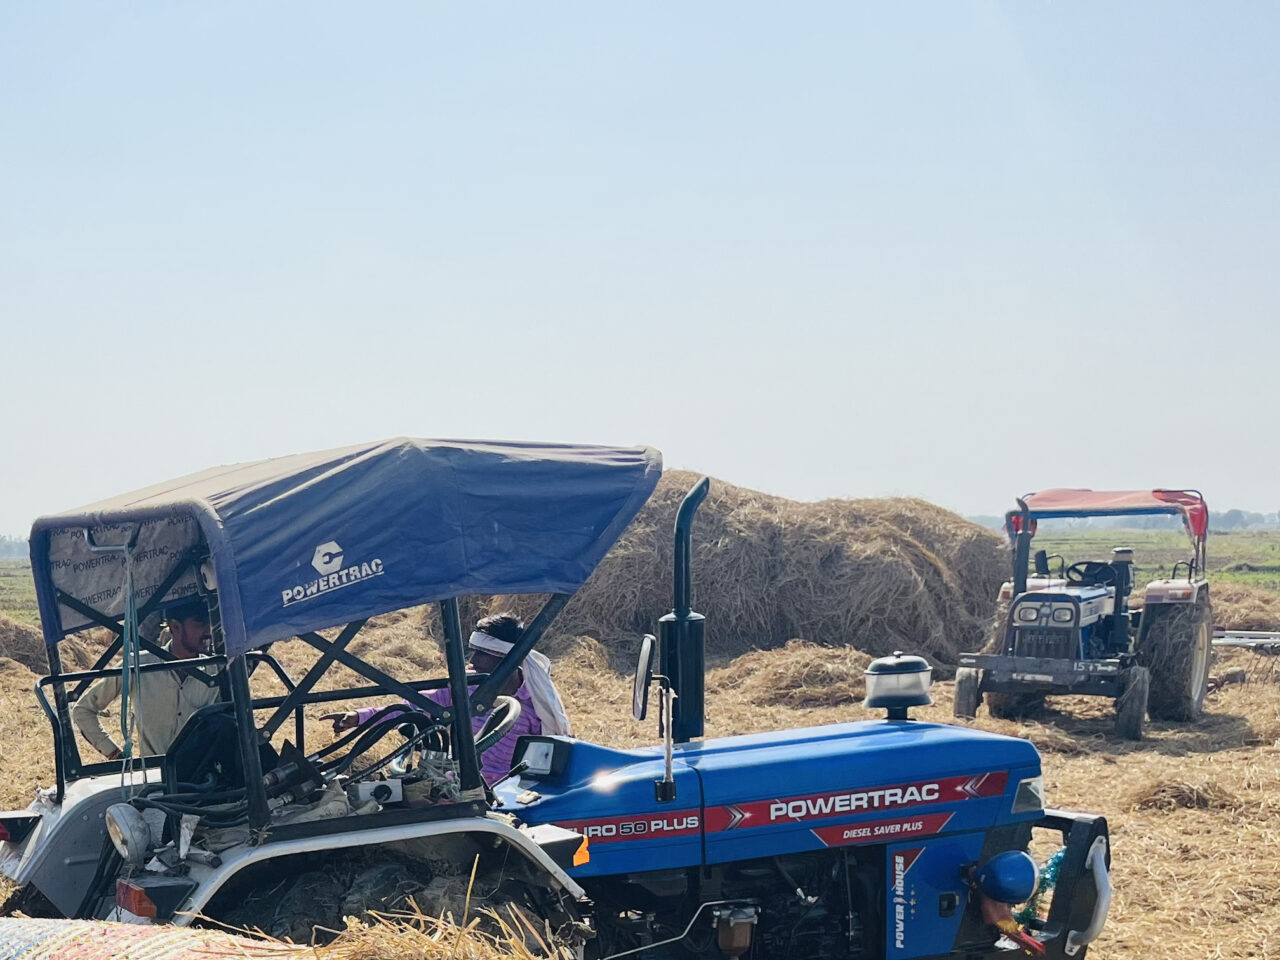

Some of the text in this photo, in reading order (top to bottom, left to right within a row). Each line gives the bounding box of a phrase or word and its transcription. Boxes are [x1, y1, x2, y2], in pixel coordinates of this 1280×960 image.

[281, 558, 384, 604] POWERTRAC
[770, 783, 940, 821] POWERTRAC
[620, 821, 647, 836] 50
[650, 816, 699, 832] PLUS
[843, 821, 923, 839] DIESEL SAVER PLUS
[895, 855, 904, 949] POWER HOUSE
